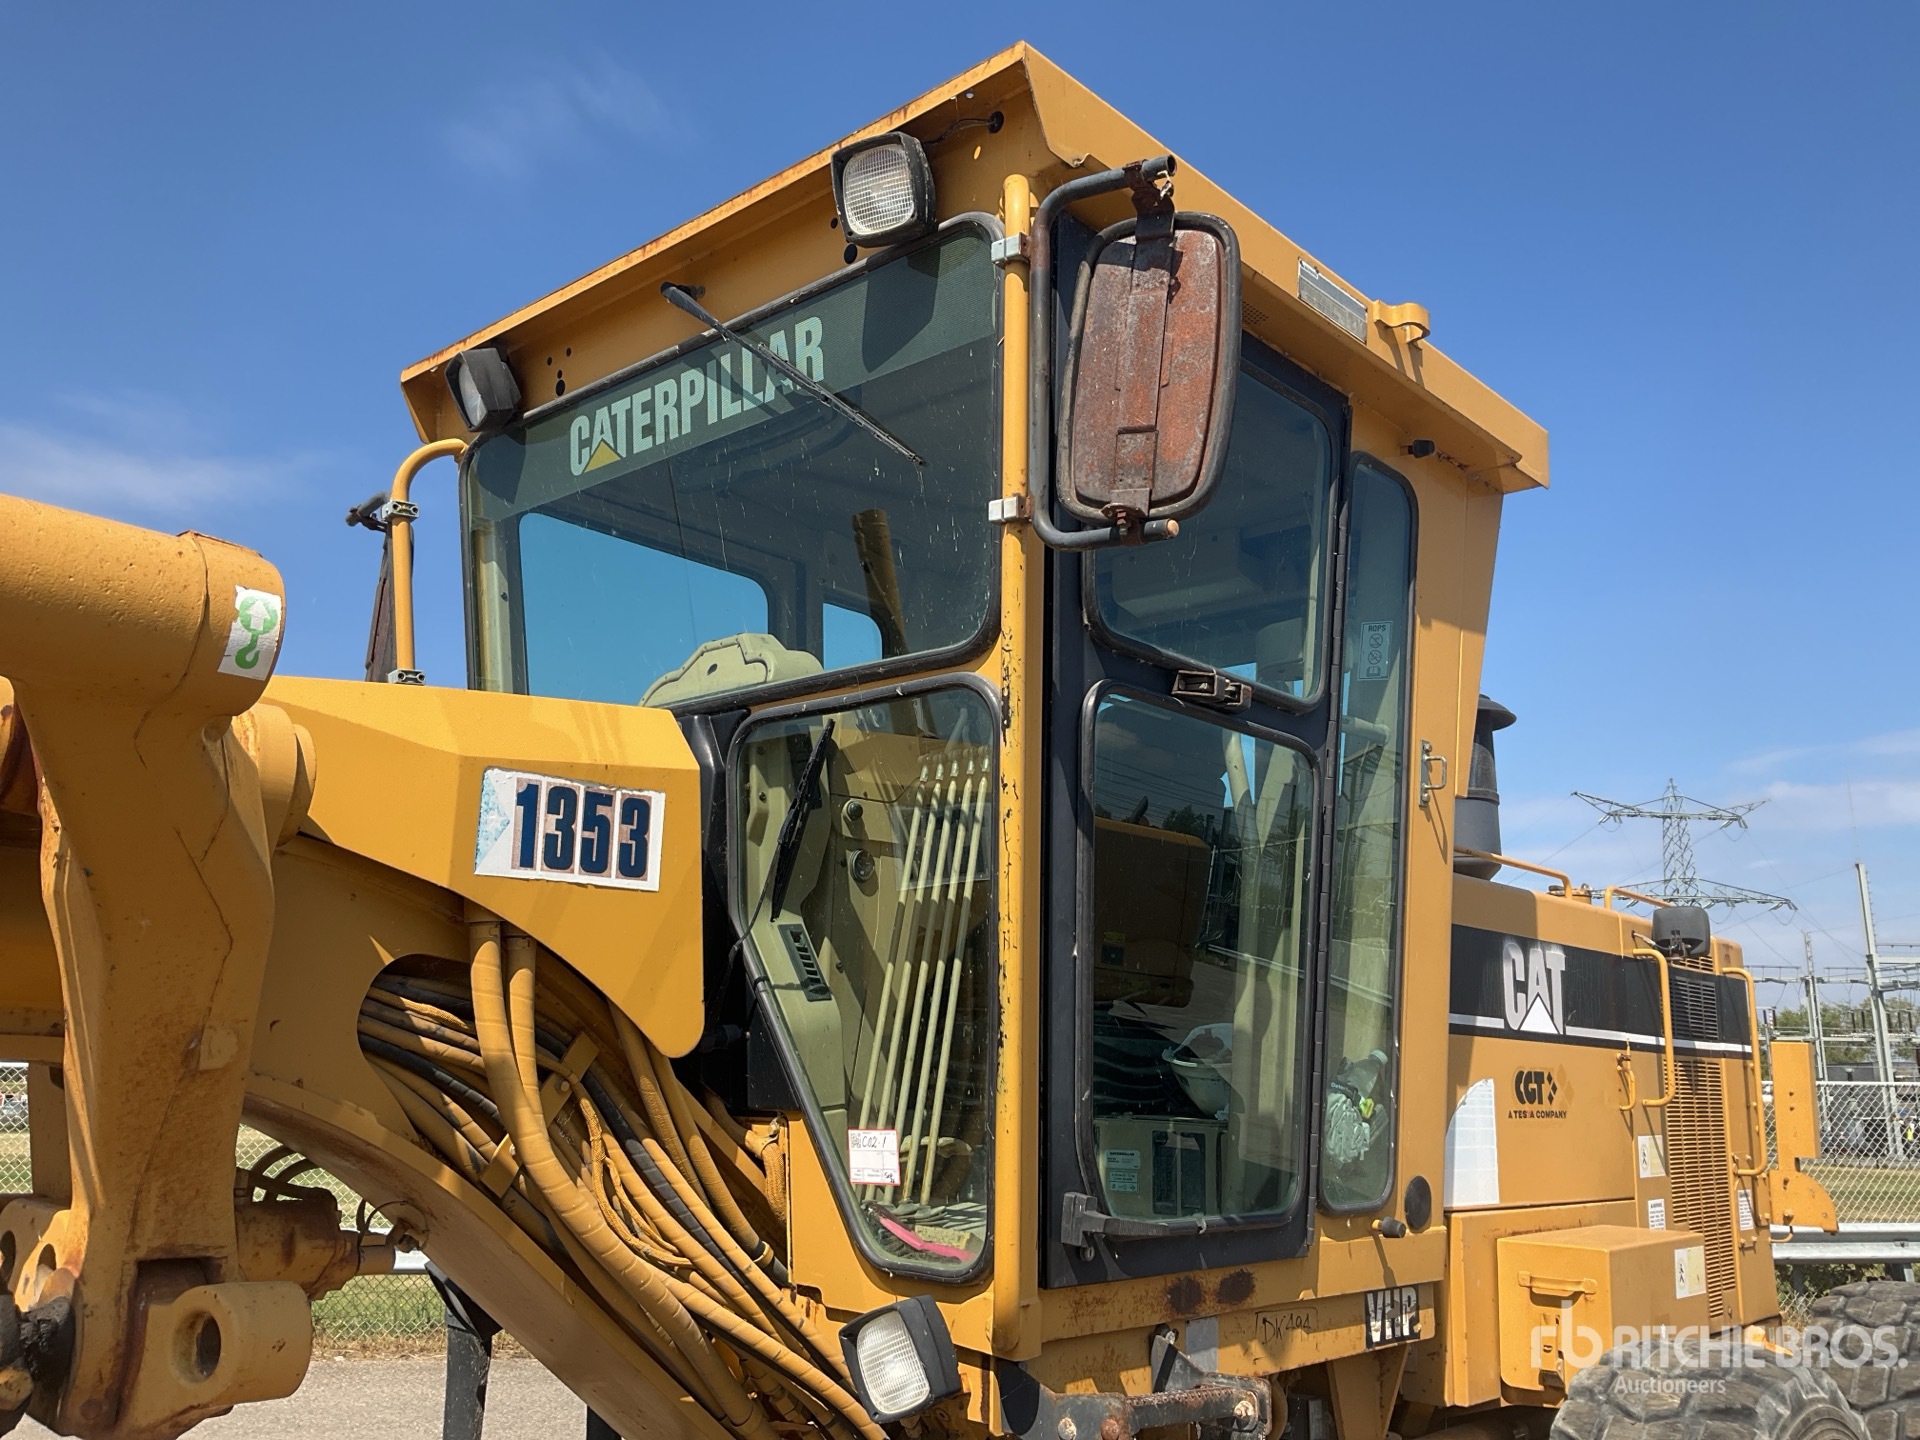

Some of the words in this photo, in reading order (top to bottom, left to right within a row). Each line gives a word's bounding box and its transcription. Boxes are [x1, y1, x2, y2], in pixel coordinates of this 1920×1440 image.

[569, 316, 825, 477] CATERPILLAR
[1368, 624, 1386, 632] ROPS
[515, 783, 651, 878] 1353
[1503, 942, 1565, 1034] CAT
[1515, 1070, 1544, 1105] CGT
[1536, 1110, 1567, 1119] COMPANY
[1366, 1287, 1418, 1343] VHP
